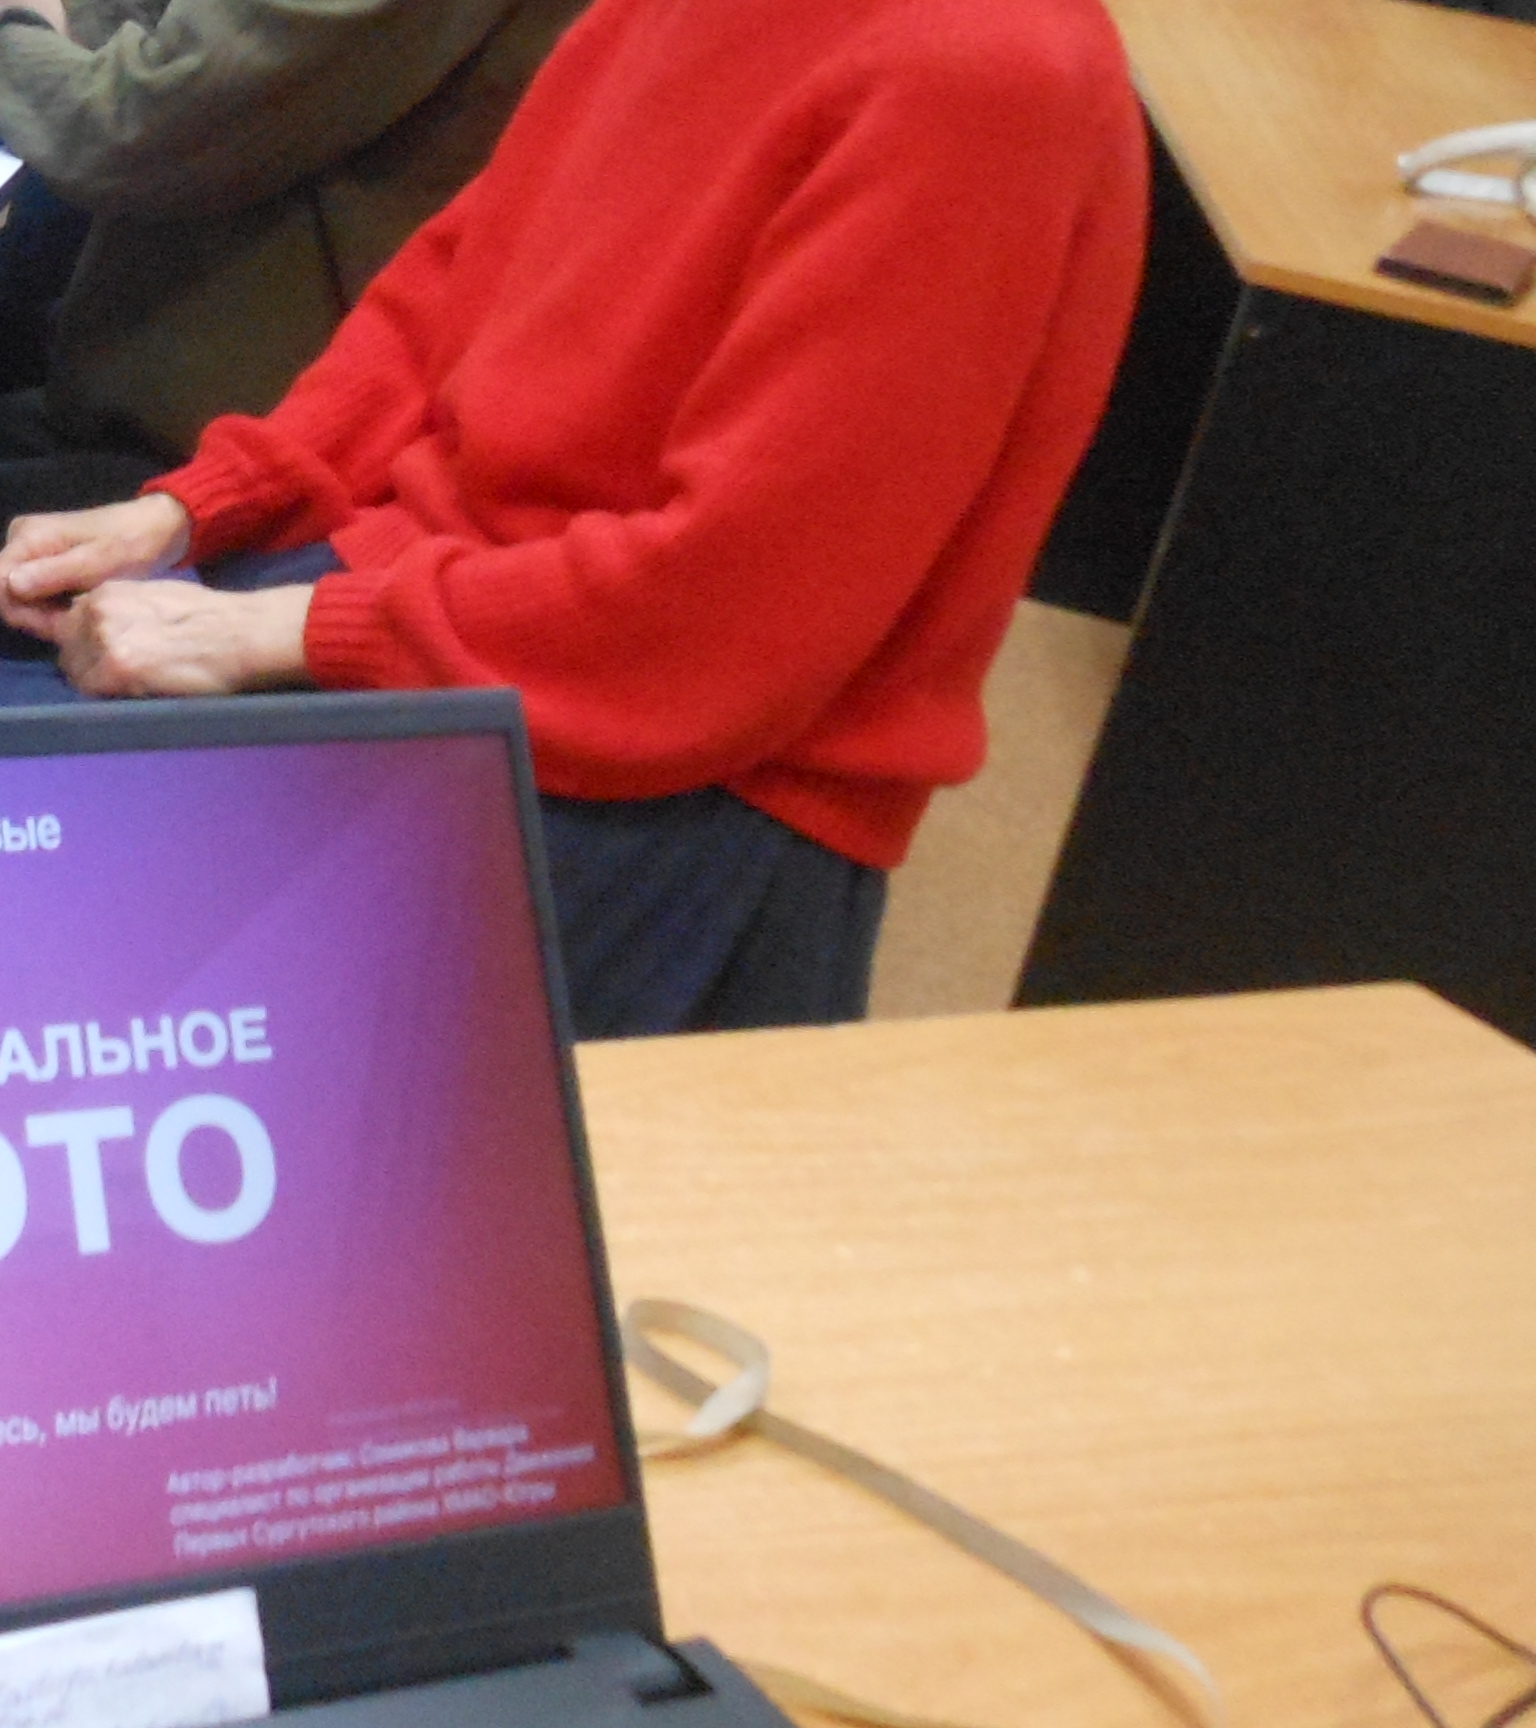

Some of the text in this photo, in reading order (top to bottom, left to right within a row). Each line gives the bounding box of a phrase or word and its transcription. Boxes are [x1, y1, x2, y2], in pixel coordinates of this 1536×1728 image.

[54, 1408, 99, 1436] мы
[106, 1393, 197, 1435] будем
[205, 1376, 277, 1416] петь!
